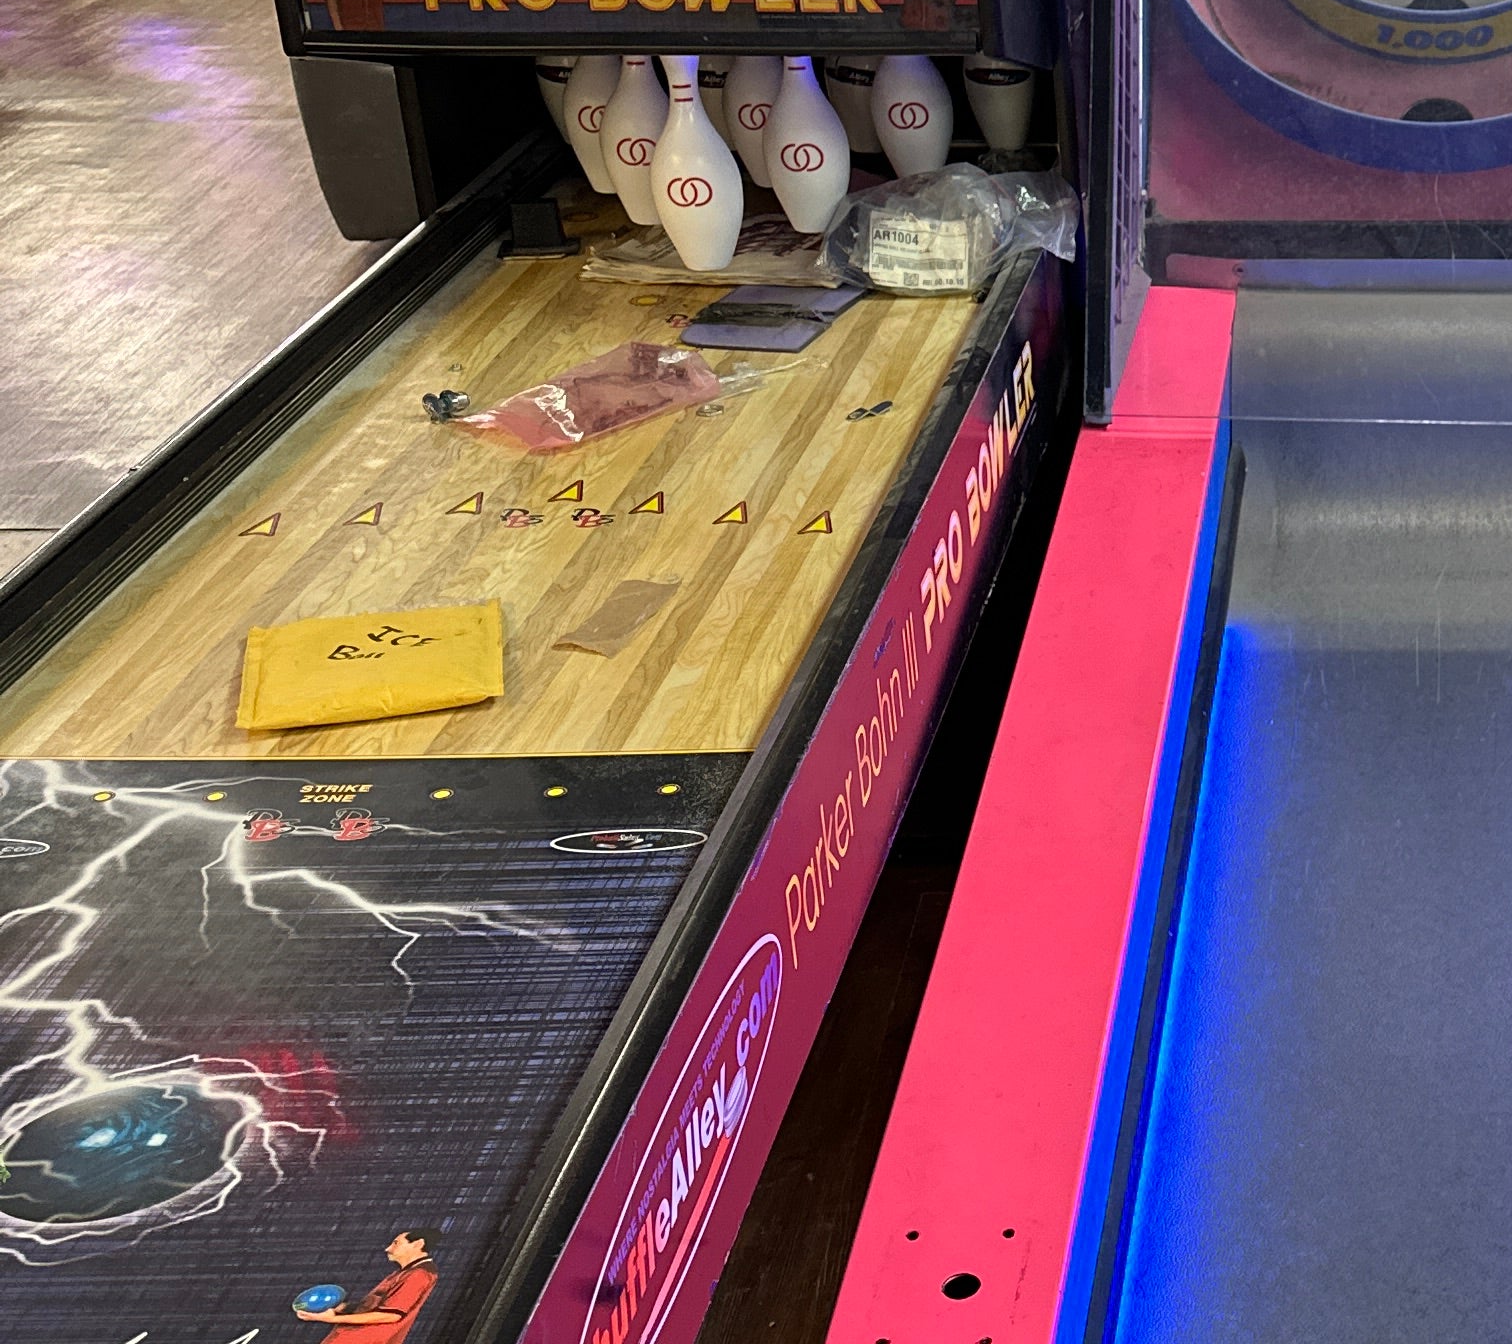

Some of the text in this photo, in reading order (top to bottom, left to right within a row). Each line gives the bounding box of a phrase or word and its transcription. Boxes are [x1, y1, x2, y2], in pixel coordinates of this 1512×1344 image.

[873, 229, 919, 246] AR1004
[784, 767, 857, 969] Parker
[854, 669, 904, 807] Bohn
[919, 509, 965, 654] PRO
[965, 340, 1036, 549] BOWLER
[299, 784, 373, 792] STRIKE
[607, 978, 746, 1286] WHERE NOSTALGIA MEETS TECHNOLOGY
